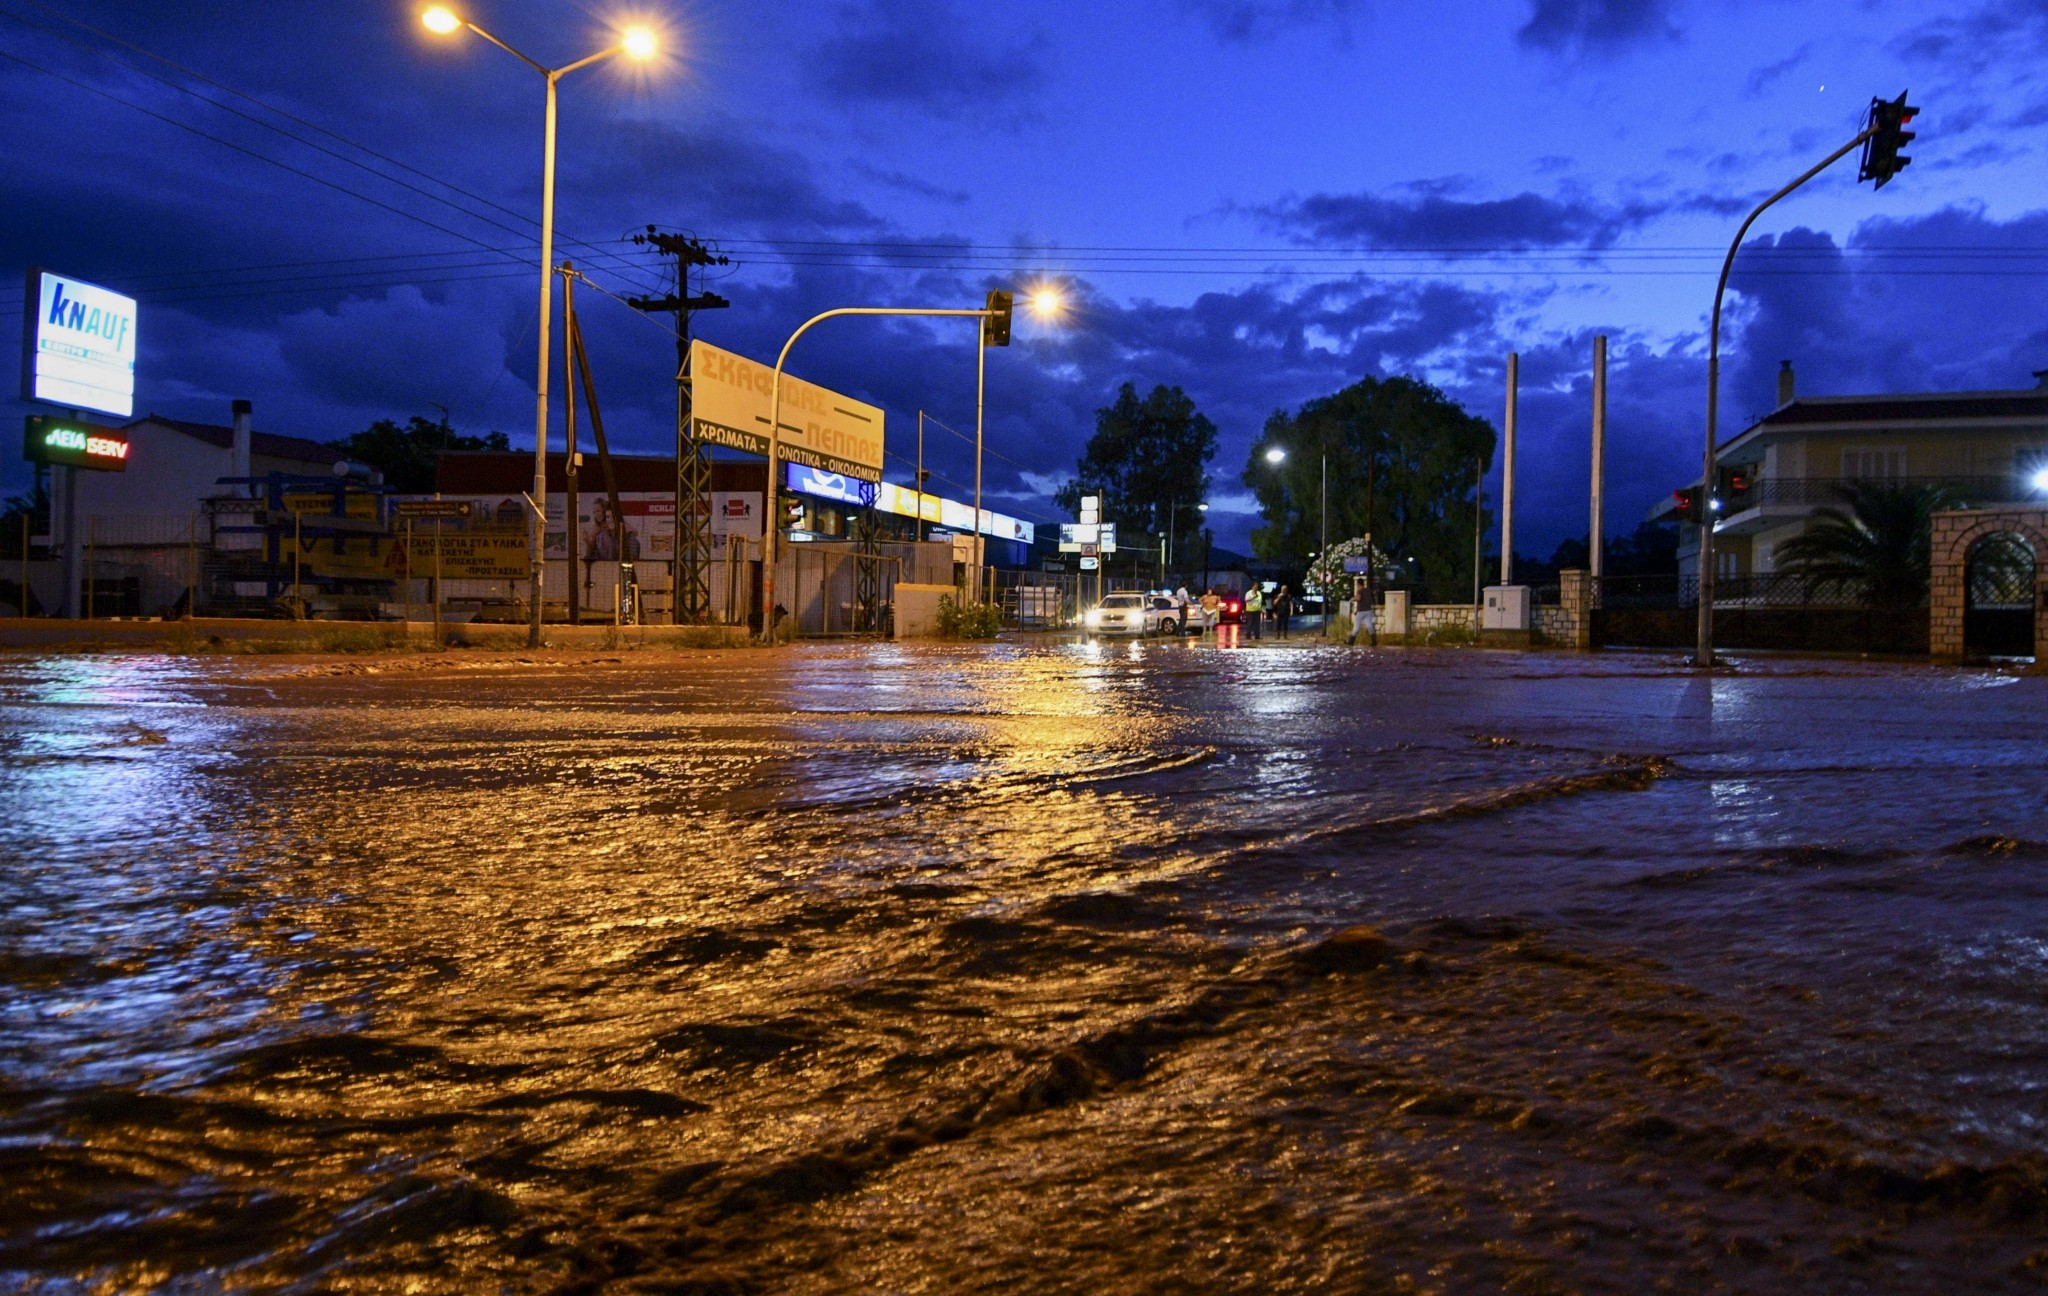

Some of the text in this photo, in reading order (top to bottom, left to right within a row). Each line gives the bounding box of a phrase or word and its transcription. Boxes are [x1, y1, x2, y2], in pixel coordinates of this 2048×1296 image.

[48, 282, 129, 352] KNAUF
[699, 422, 758, 452] ΧΡΩΜΑΤΑ
[768, 443, 821, 469] ΟΝΩΤΙΚΑ
[828, 459, 881, 483] ΟΙΚΟΔΟΜΙΚΑ
[648, 504, 677, 513] BERLIN
